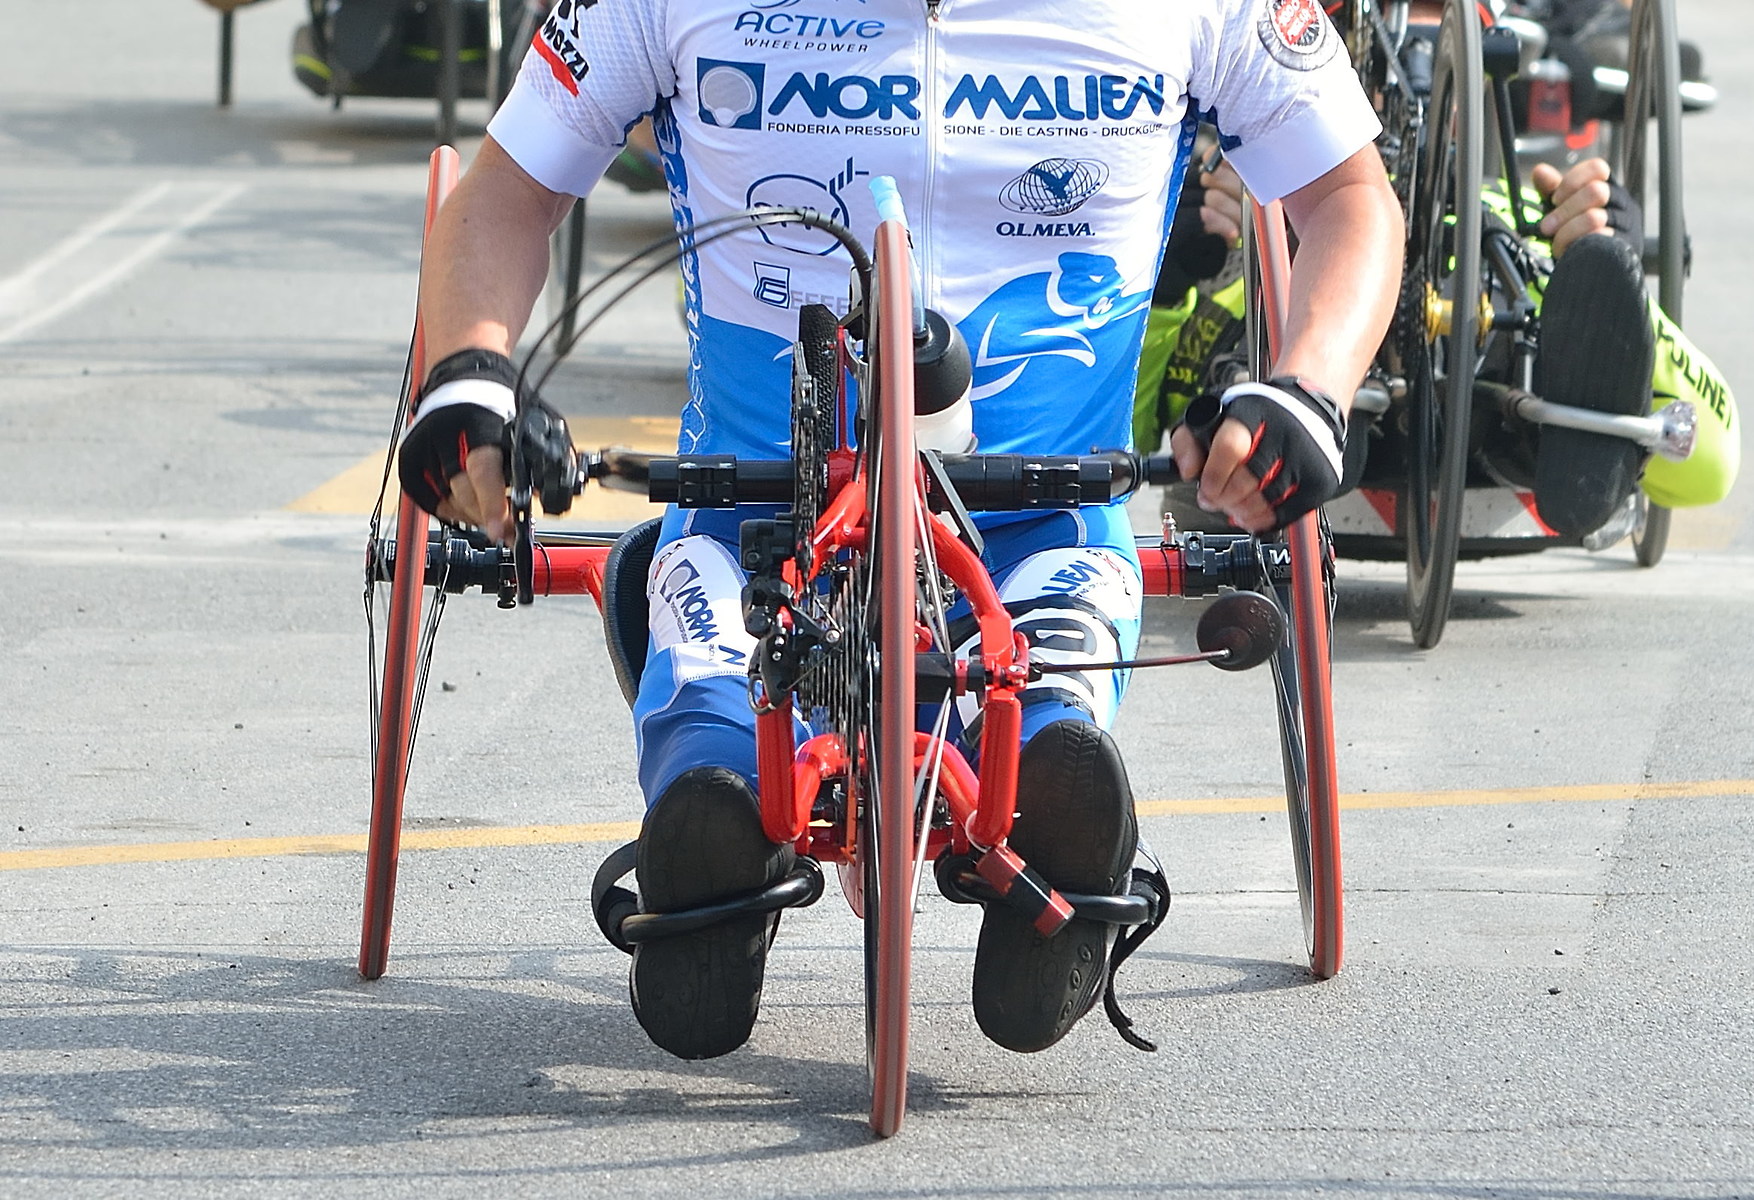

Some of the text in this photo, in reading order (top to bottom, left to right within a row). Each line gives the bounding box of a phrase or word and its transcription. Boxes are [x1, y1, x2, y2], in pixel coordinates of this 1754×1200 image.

[543, 16, 589, 81] MOZZI
[744, 38, 869, 53] WHEELPOWER
[768, 122, 841, 135] FONDERIA
[845, 124, 921, 136] PRESSOFU
[944, 124, 985, 136] SIONE
[1000, 126, 1023, 136] DIE
[1027, 126, 1088, 137] CASTING
